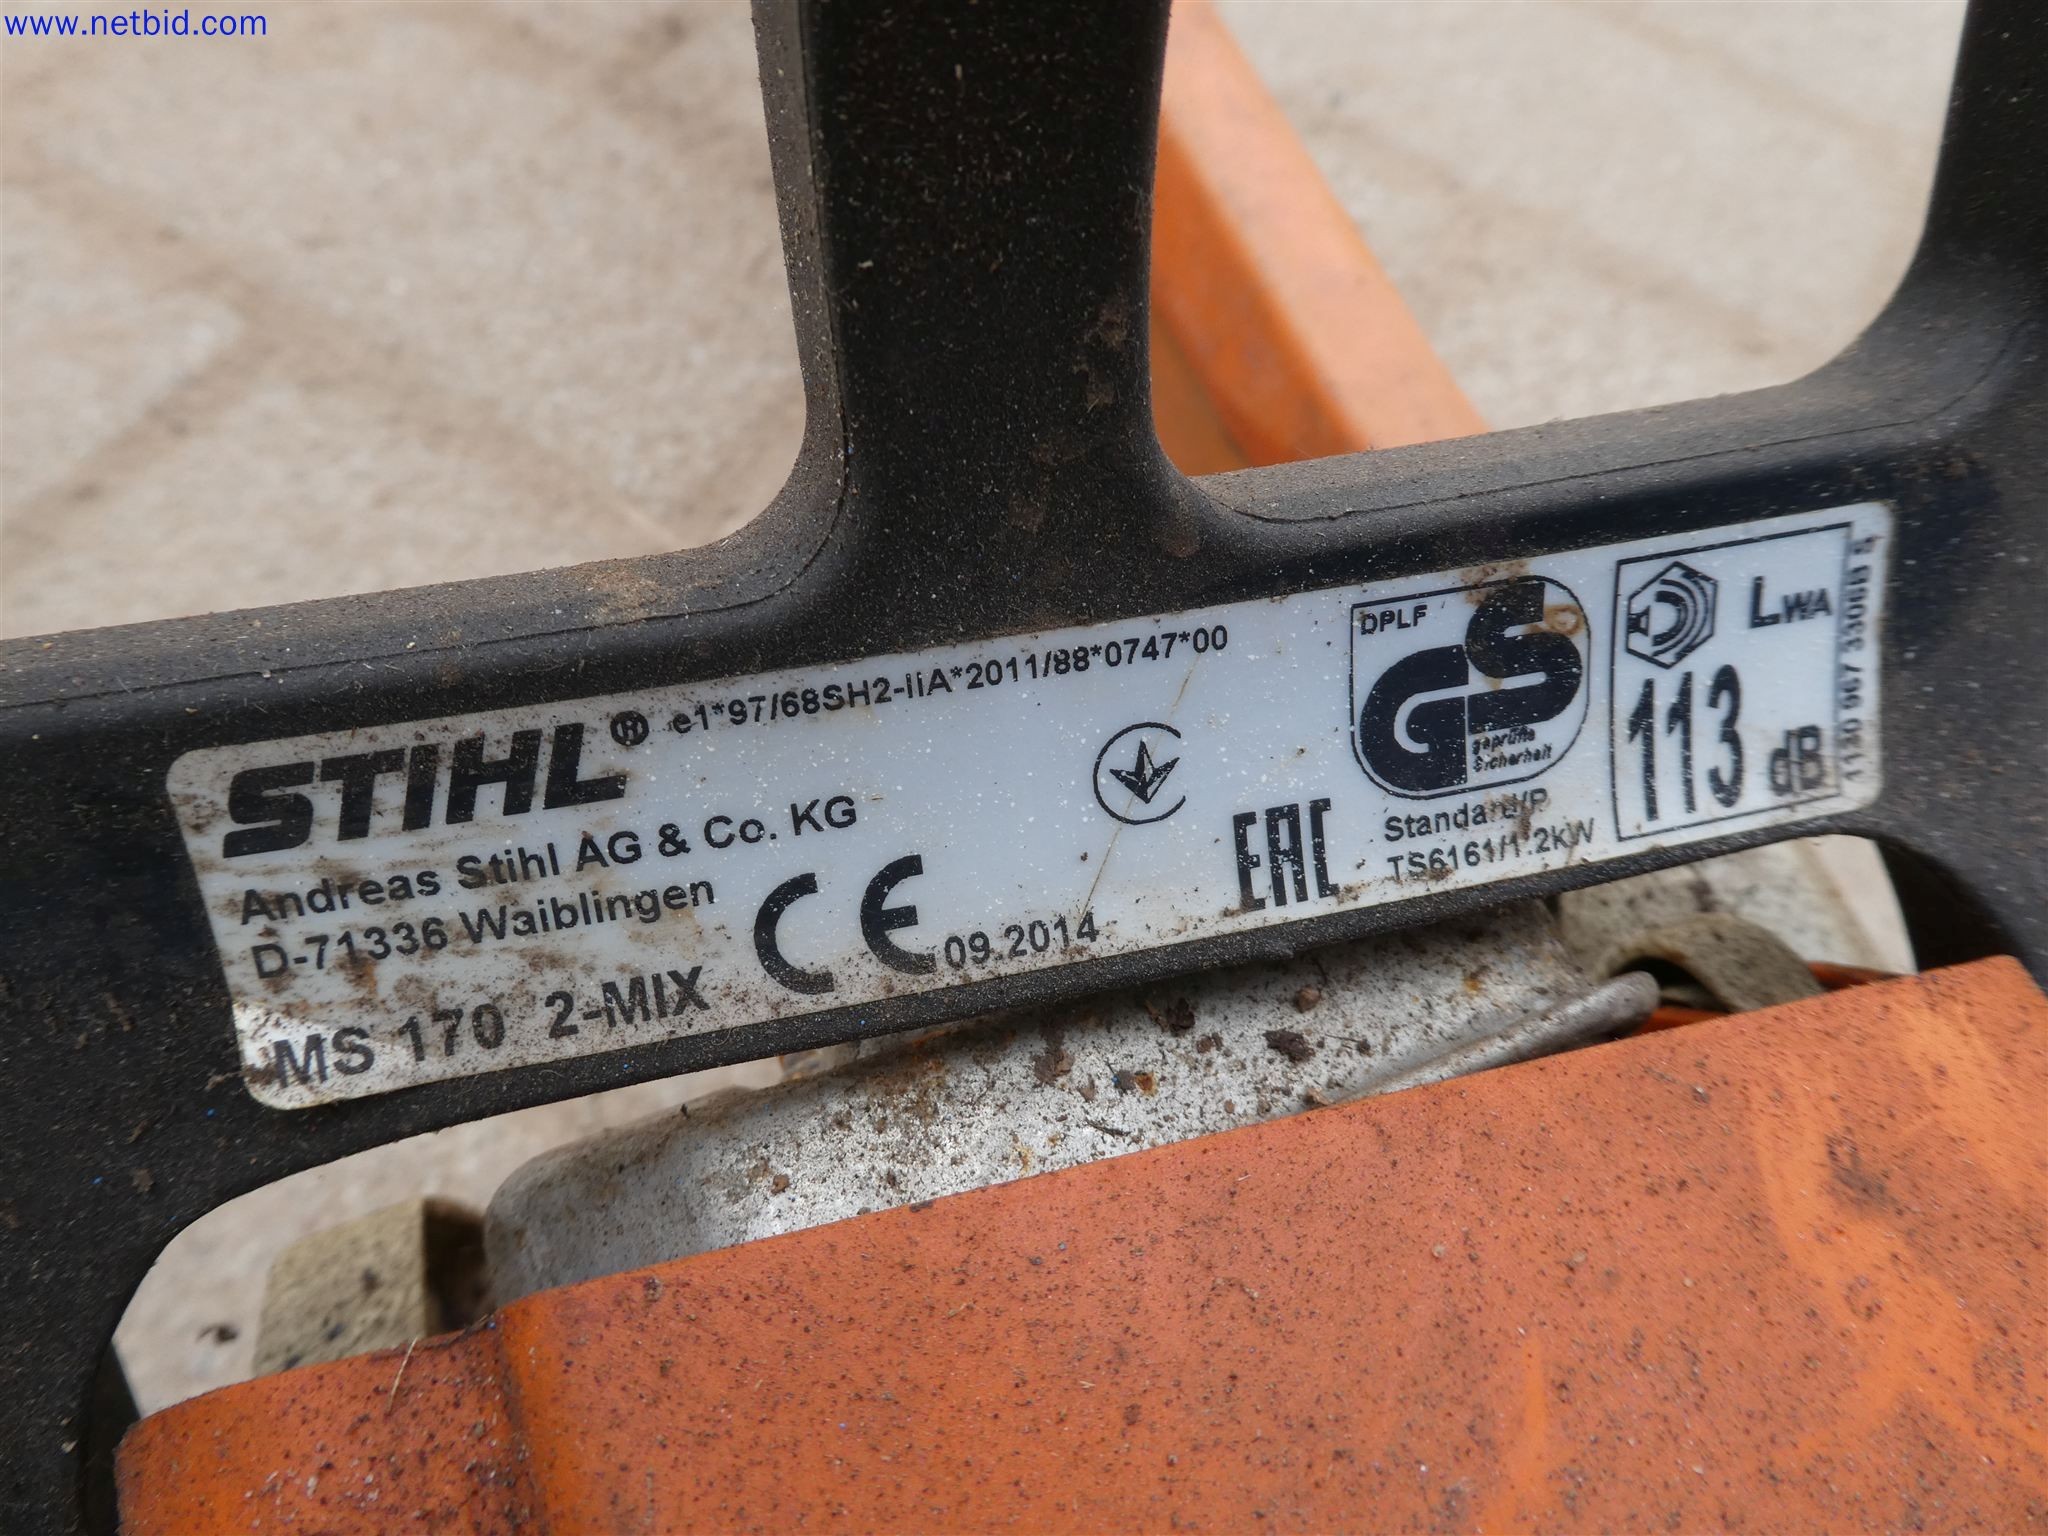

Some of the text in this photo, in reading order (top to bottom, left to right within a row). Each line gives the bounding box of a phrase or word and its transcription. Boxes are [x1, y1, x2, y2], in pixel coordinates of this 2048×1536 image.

[1360, 605, 1429, 635] DPLF
[1359, 582, 1583, 792] GS
[1628, 664, 1824, 821] 113 dB
[241, 795, 857, 926] Andreas Stihl AG & Co. KG
[251, 879, 715, 979] D-71336 Waiblingen
[753, 854, 937, 995] CE
[944, 910, 1100, 969] 09.2014
[272, 966, 711, 1088] MS 170 2-MIX
